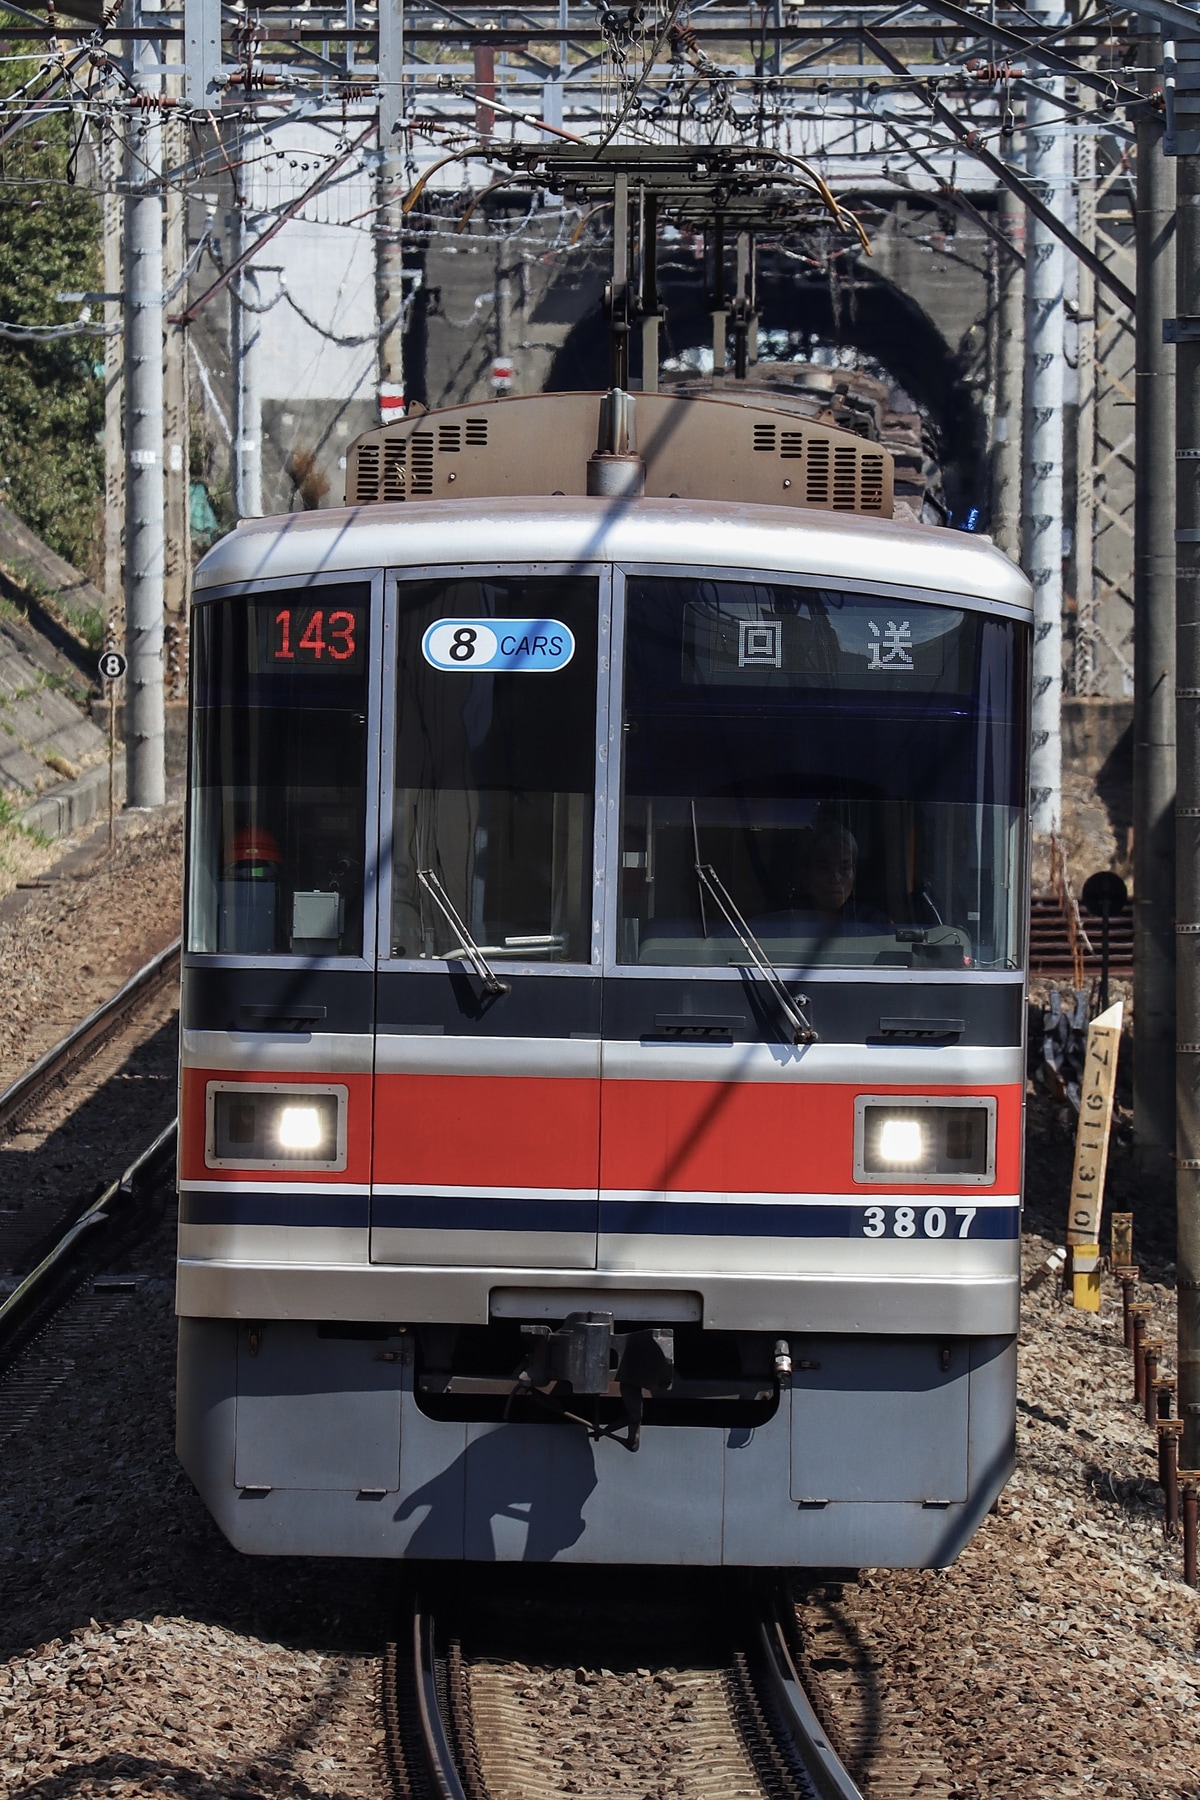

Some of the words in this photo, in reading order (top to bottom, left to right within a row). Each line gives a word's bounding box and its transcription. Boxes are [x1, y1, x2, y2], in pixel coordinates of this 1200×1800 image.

[274, 609, 356, 660] 143
[448, 627, 478, 662] 8
[500, 635, 564, 657] CARS
[738, 620, 915, 670] 回送
[106, 655, 121, 676] 8
[862, 1206, 977, 1238] 3807
